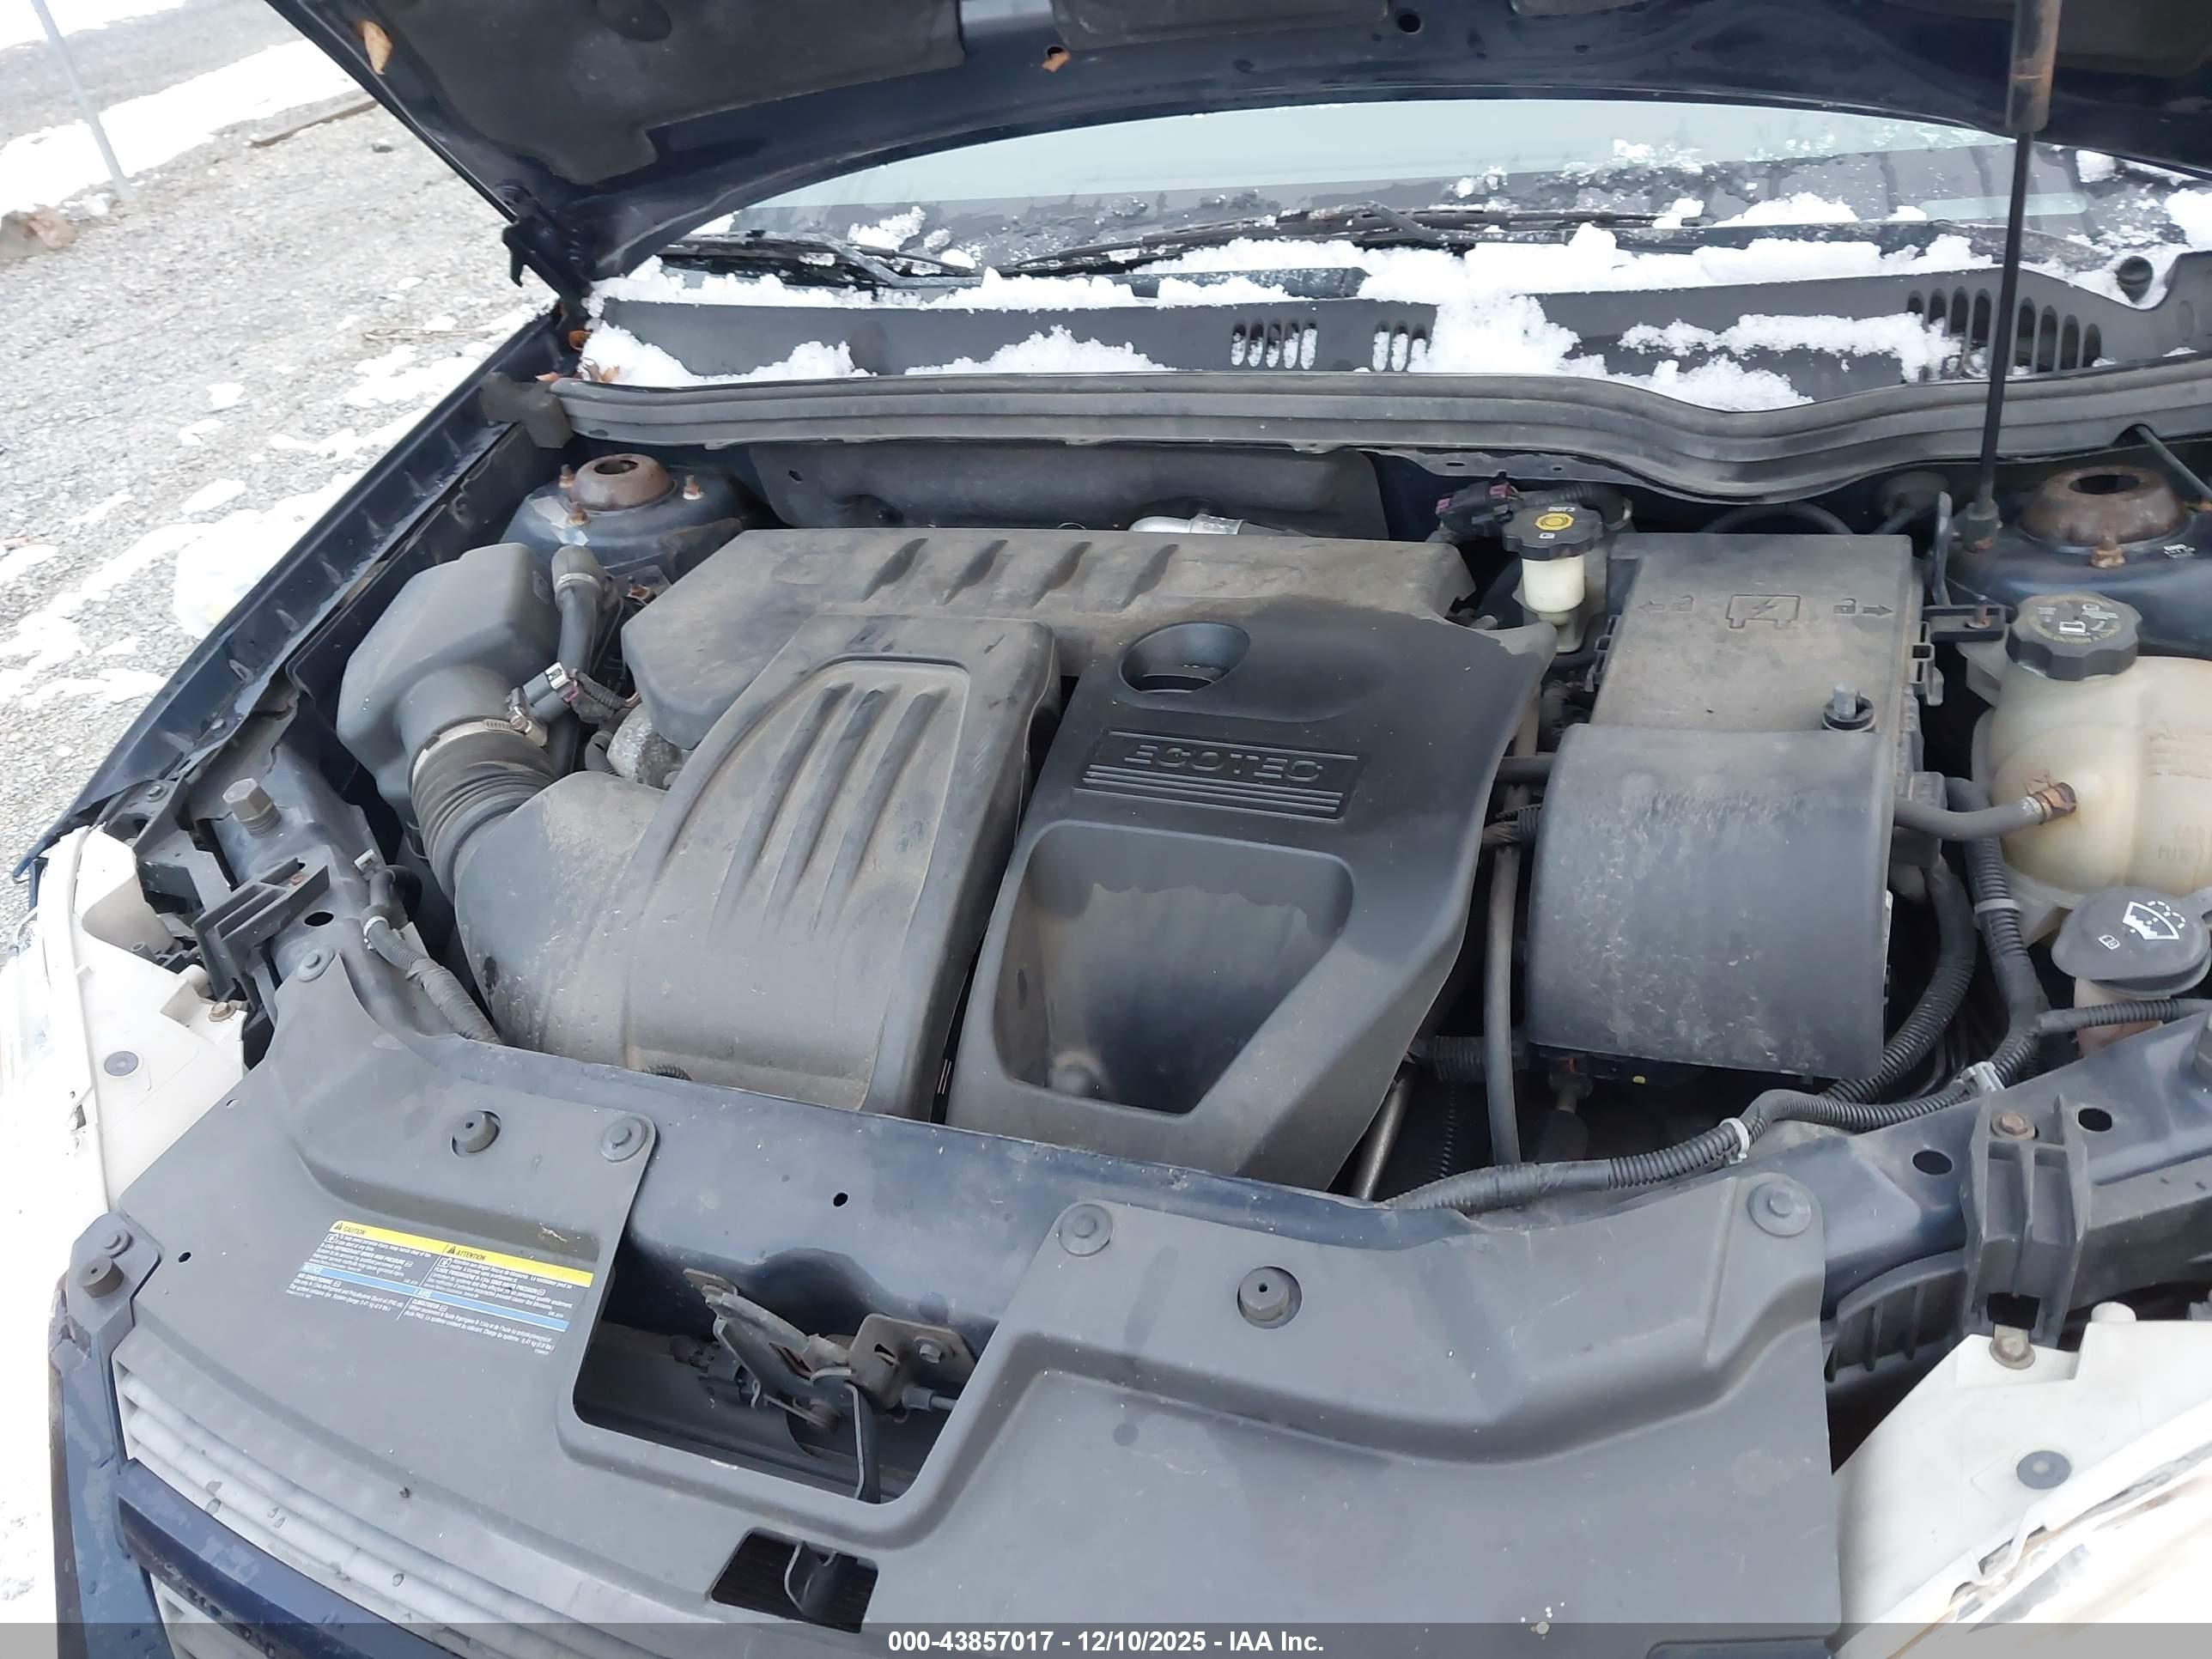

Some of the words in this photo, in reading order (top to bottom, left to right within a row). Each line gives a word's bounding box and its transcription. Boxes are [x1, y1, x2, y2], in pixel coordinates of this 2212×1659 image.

[1124, 744, 1324, 783] ECOTEC
[343, 1225, 367, 1236] CAUTION
[456, 1249, 487, 1261] ATTENTION
